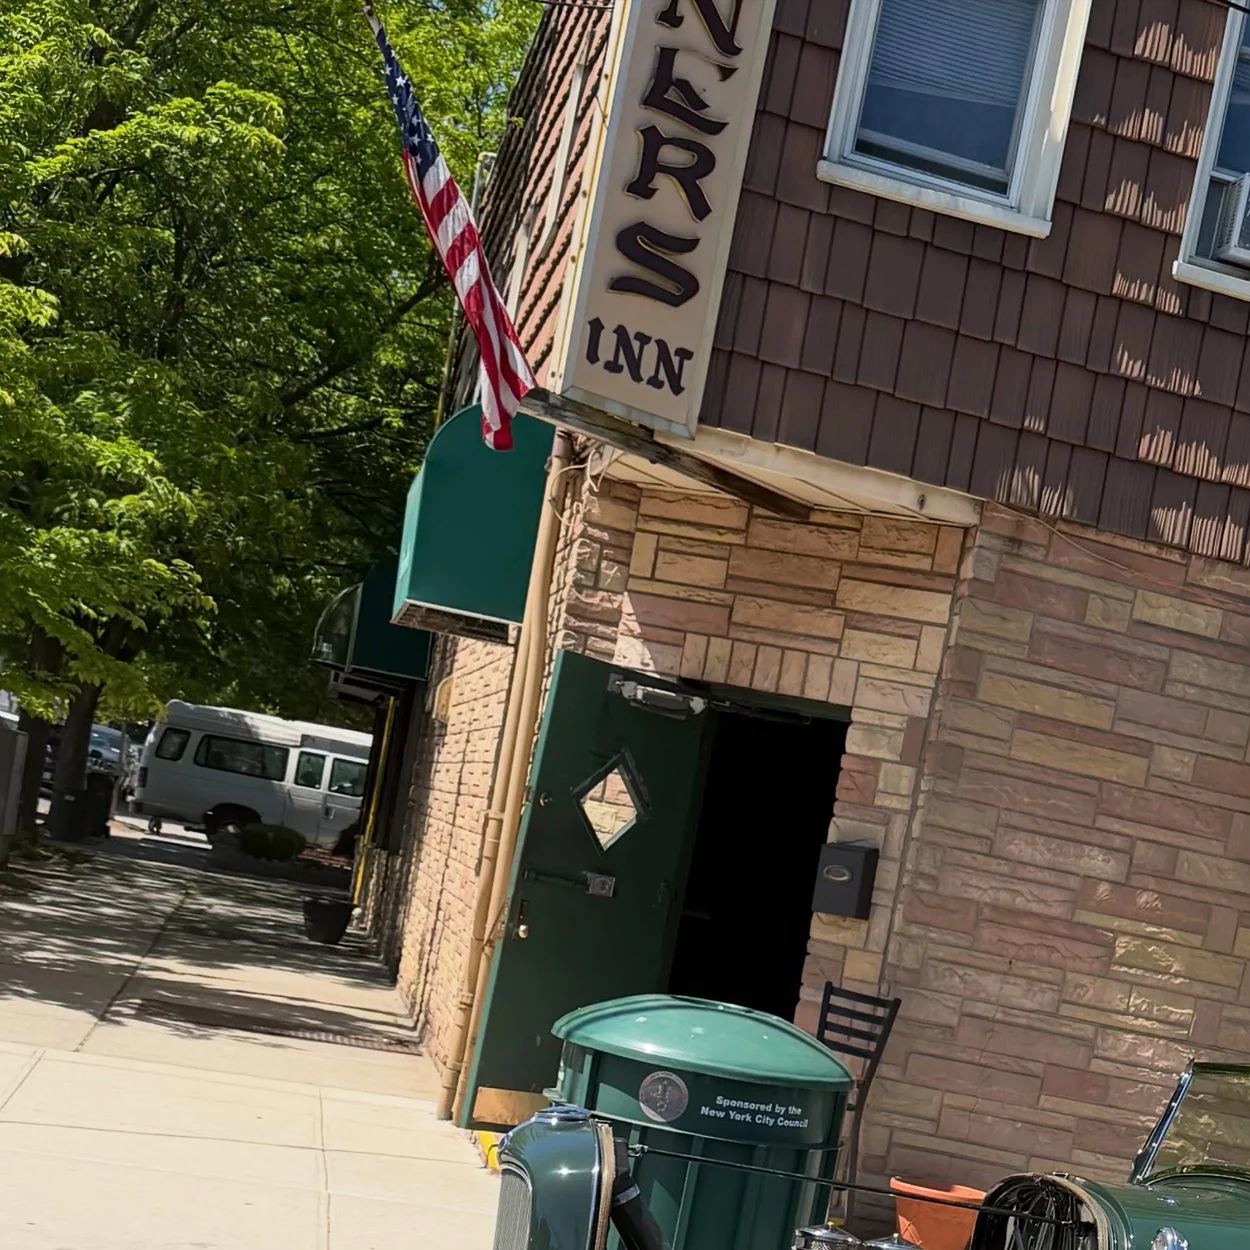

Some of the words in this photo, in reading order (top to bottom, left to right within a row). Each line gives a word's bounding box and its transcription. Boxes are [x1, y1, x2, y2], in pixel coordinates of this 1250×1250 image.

[585, 316, 694, 397] INN
[700, 1105, 725, 1119] New
[728, 1110, 752, 1124] York
[755, 1114, 775, 1127] City
[777, 1117, 808, 1129] Council
[715, 1095, 772, 1113] Sponsored
[774, 1104, 786, 1116] by
[788, 1105, 802, 1116] the
